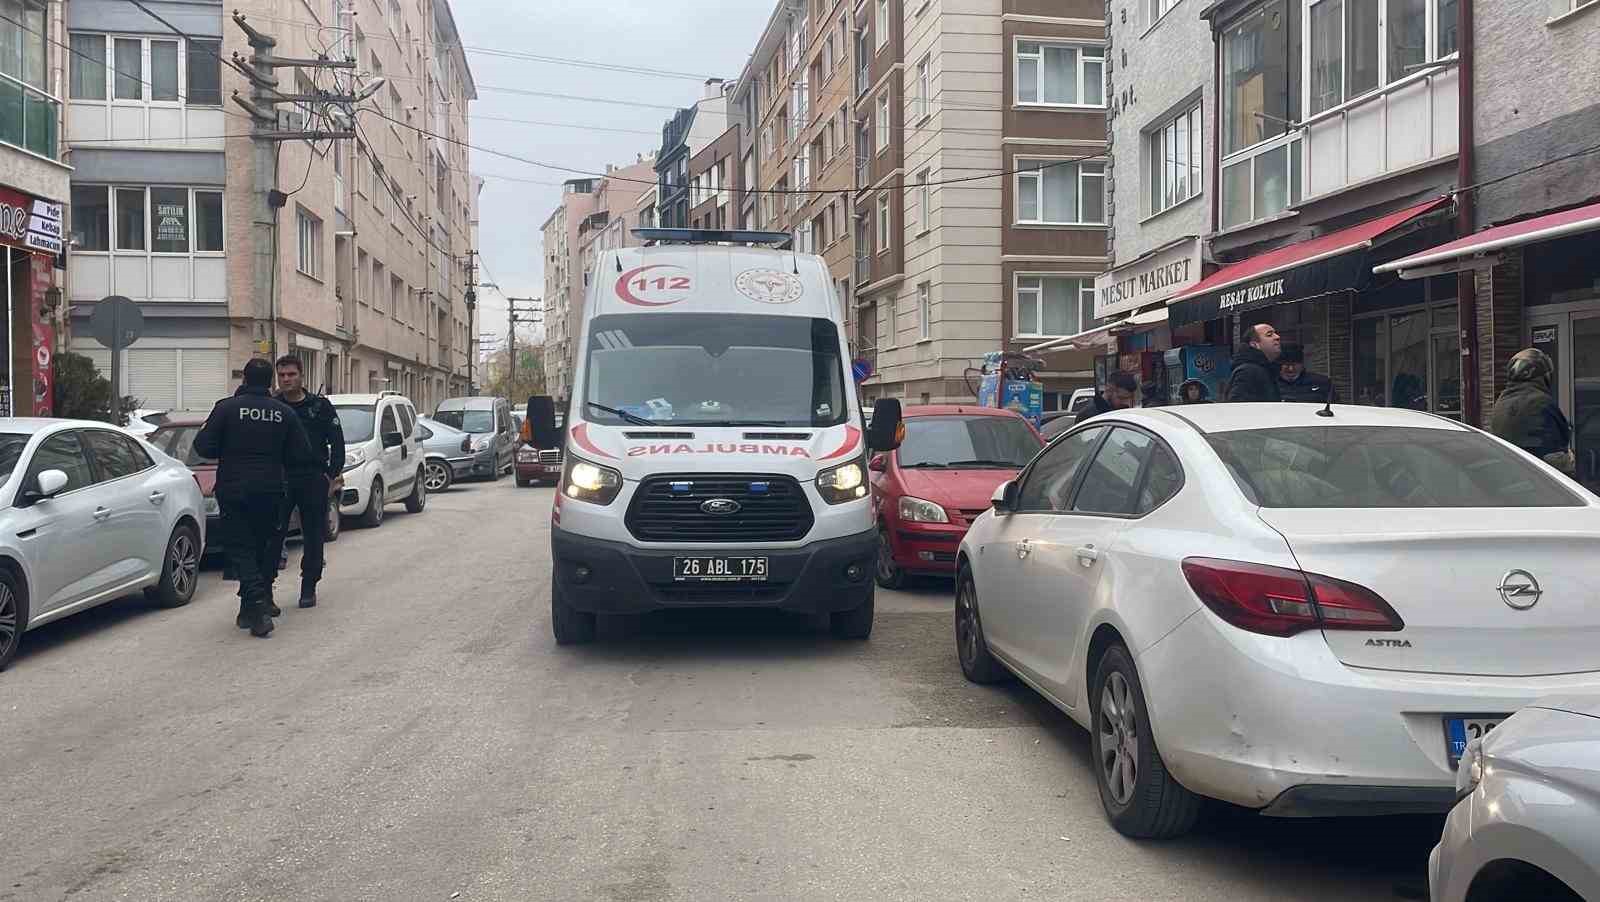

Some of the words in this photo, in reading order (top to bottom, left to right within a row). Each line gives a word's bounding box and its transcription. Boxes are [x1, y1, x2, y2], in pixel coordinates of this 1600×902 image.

[631, 277, 690, 291] 112
[1101, 278, 1136, 306] MESUT
[1139, 258, 1191, 296] MARKET
[1219, 289, 1246, 311] REŞAT
[1246, 279, 1284, 302] KOLTUK
[683, 559, 700, 575] 26
[707, 559, 732, 575] ABL
[741, 559, 765, 575] 175
[1364, 638, 1413, 648] ASTRA
